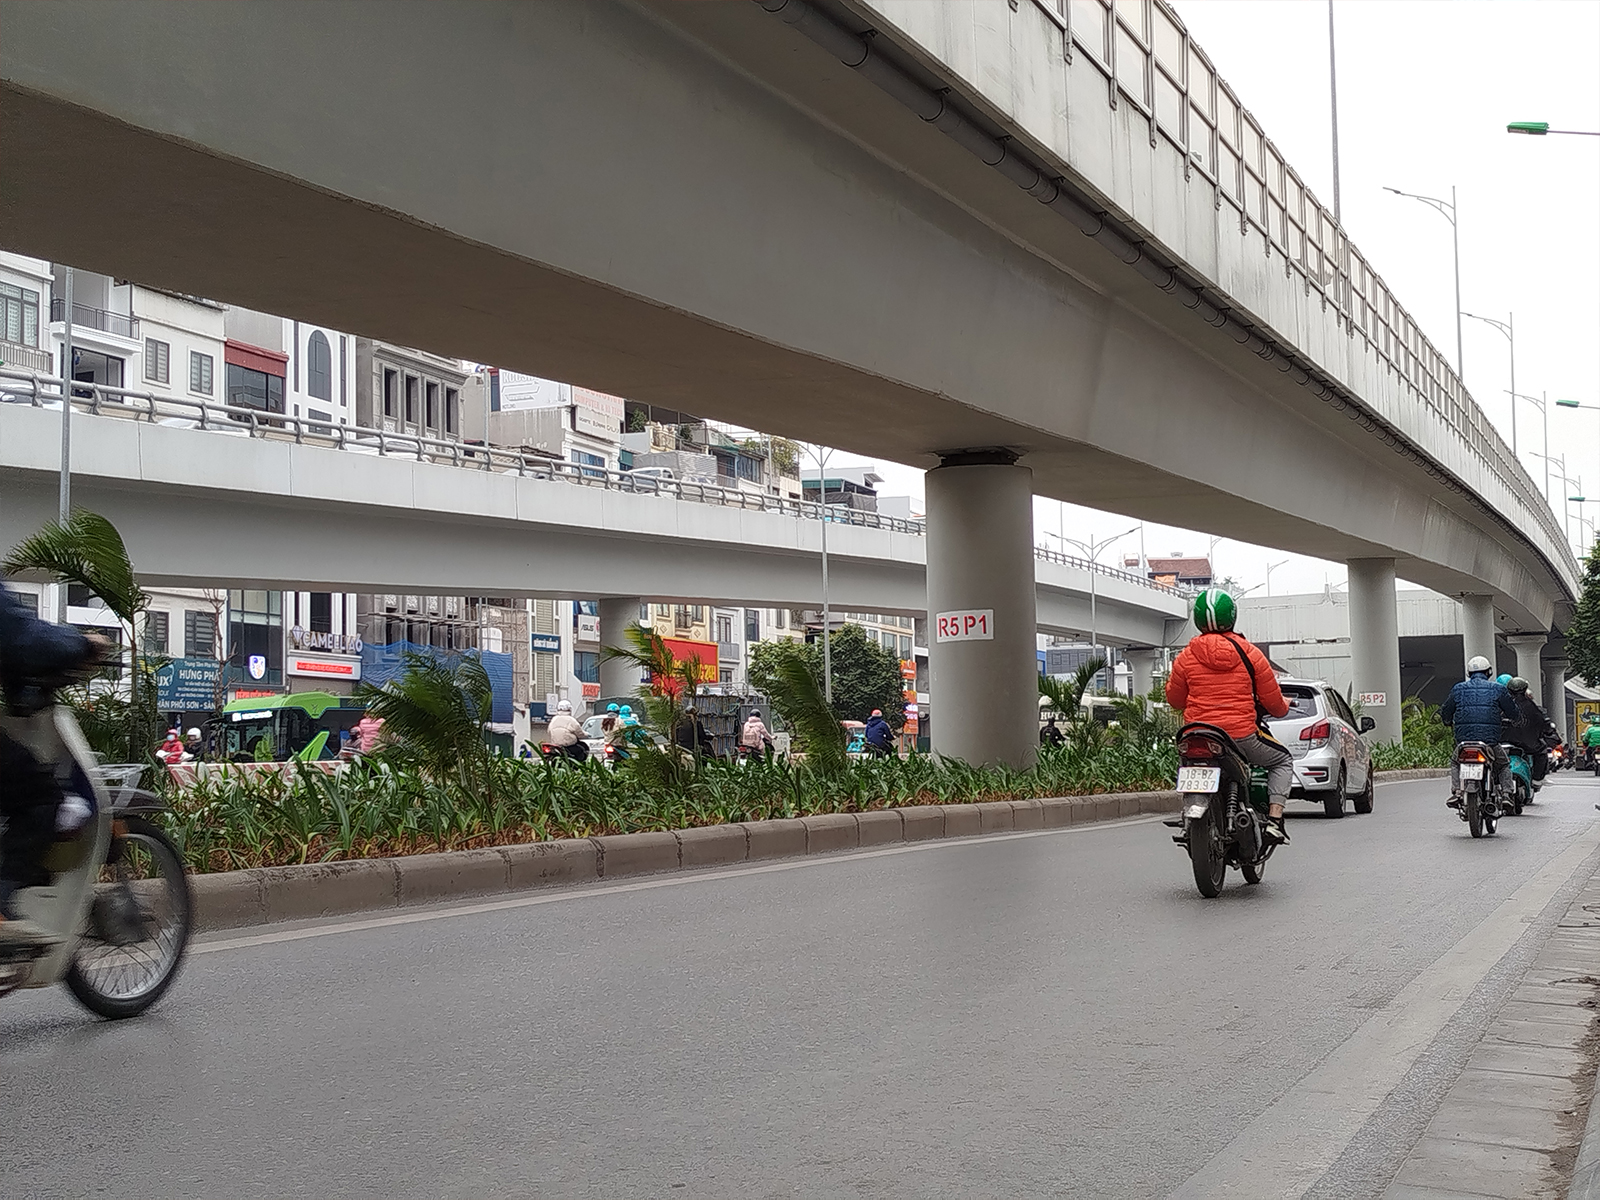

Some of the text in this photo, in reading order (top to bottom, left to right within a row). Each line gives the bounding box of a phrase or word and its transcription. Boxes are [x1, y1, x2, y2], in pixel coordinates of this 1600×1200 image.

[938, 614, 987, 637] R5 P1
[302, 631, 363, 652] CAMELLIA 6
[179, 668, 203, 680] HƯNG
[170, 698, 186, 709] PHỐI
[186, 699, 199, 709] SƠN
[1360, 694, 1385, 704] R5 P2
[1179, 780, 1216, 791] 783.97
